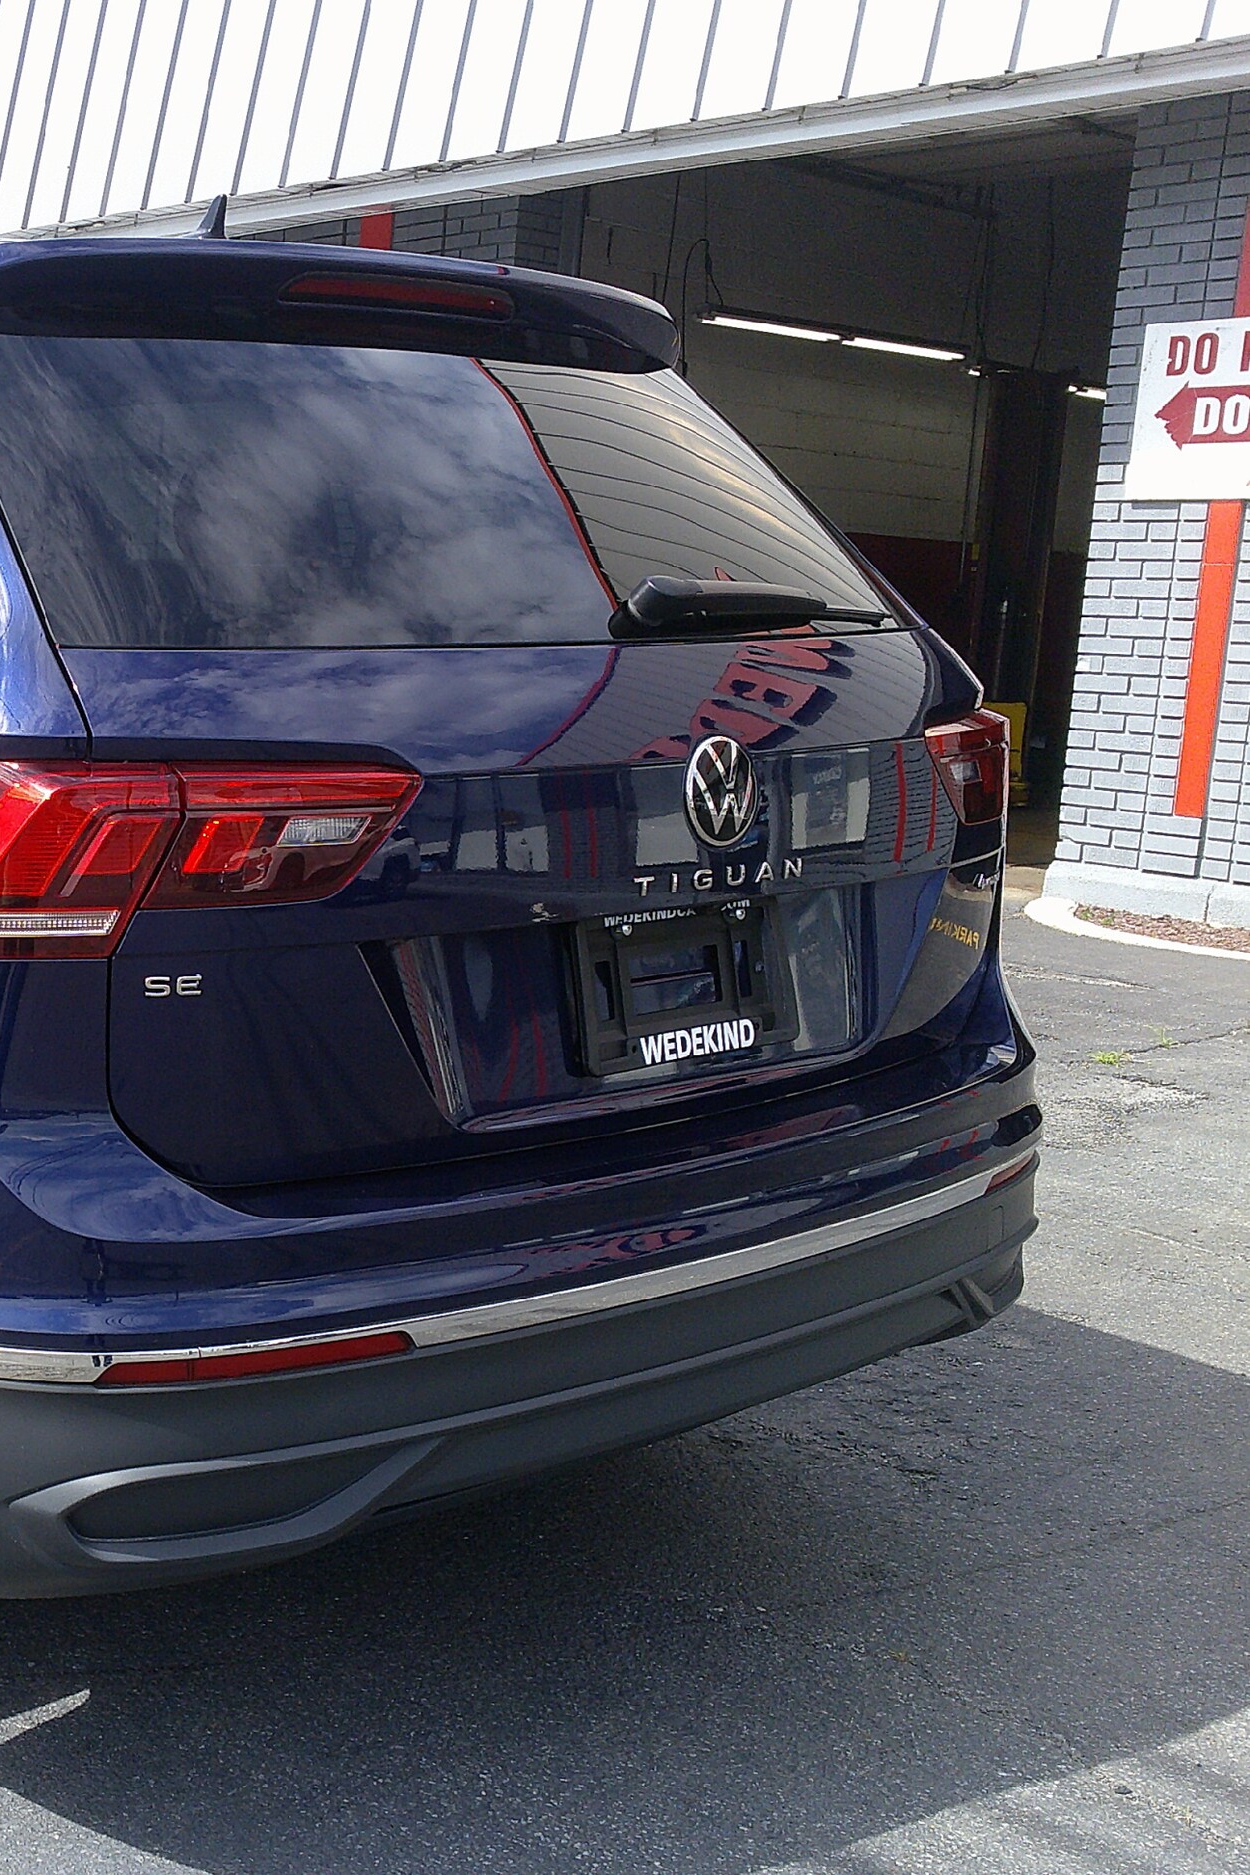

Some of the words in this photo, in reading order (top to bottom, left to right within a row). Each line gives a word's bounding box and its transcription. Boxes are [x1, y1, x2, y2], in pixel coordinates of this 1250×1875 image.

[1166, 332, 1220, 376] DO
[633, 858, 804, 898] TIGUAN
[144, 973, 203, 997] SE
[639, 1018, 756, 1066] WEDEKIND
